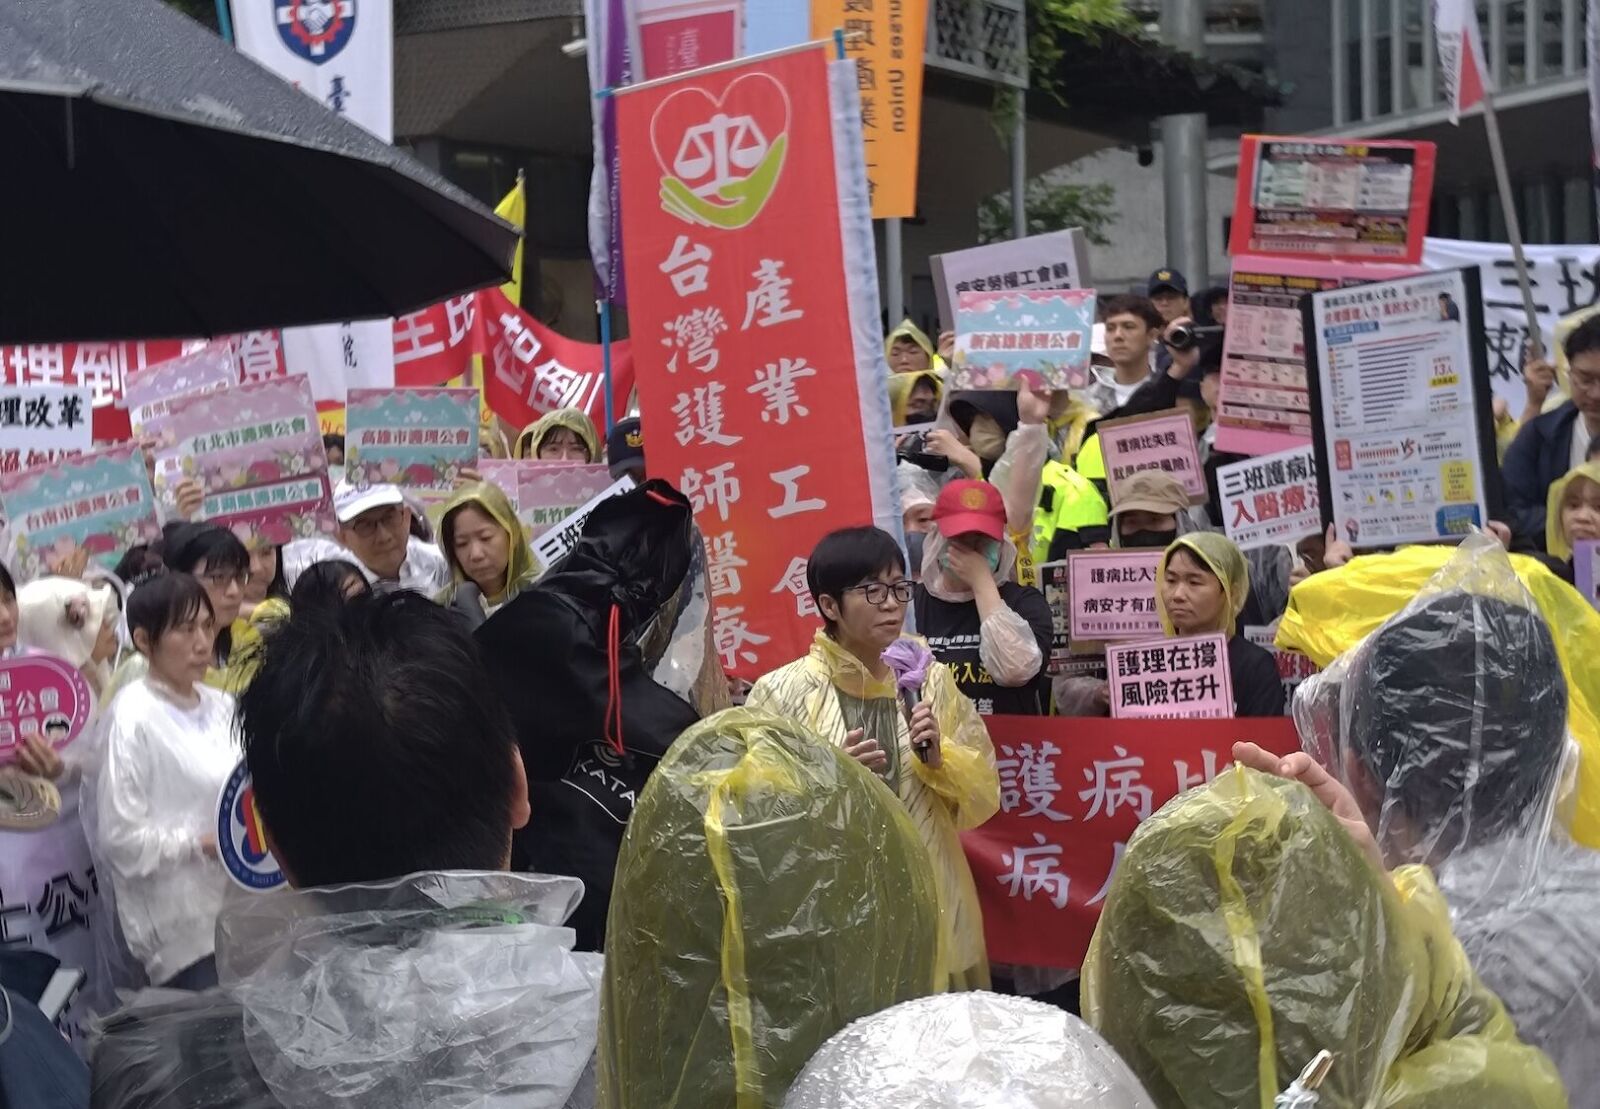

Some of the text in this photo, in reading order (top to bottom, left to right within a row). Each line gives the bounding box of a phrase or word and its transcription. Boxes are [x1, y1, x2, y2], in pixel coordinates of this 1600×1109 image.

[740, 258, 827, 618] 產業工會
[1091, 566, 1157, 584] 護病比入
[1116, 641, 1218, 677] 護理在撐
[1121, 674, 1220, 707] 風險在升
[573, 759, 636, 808] KATA
